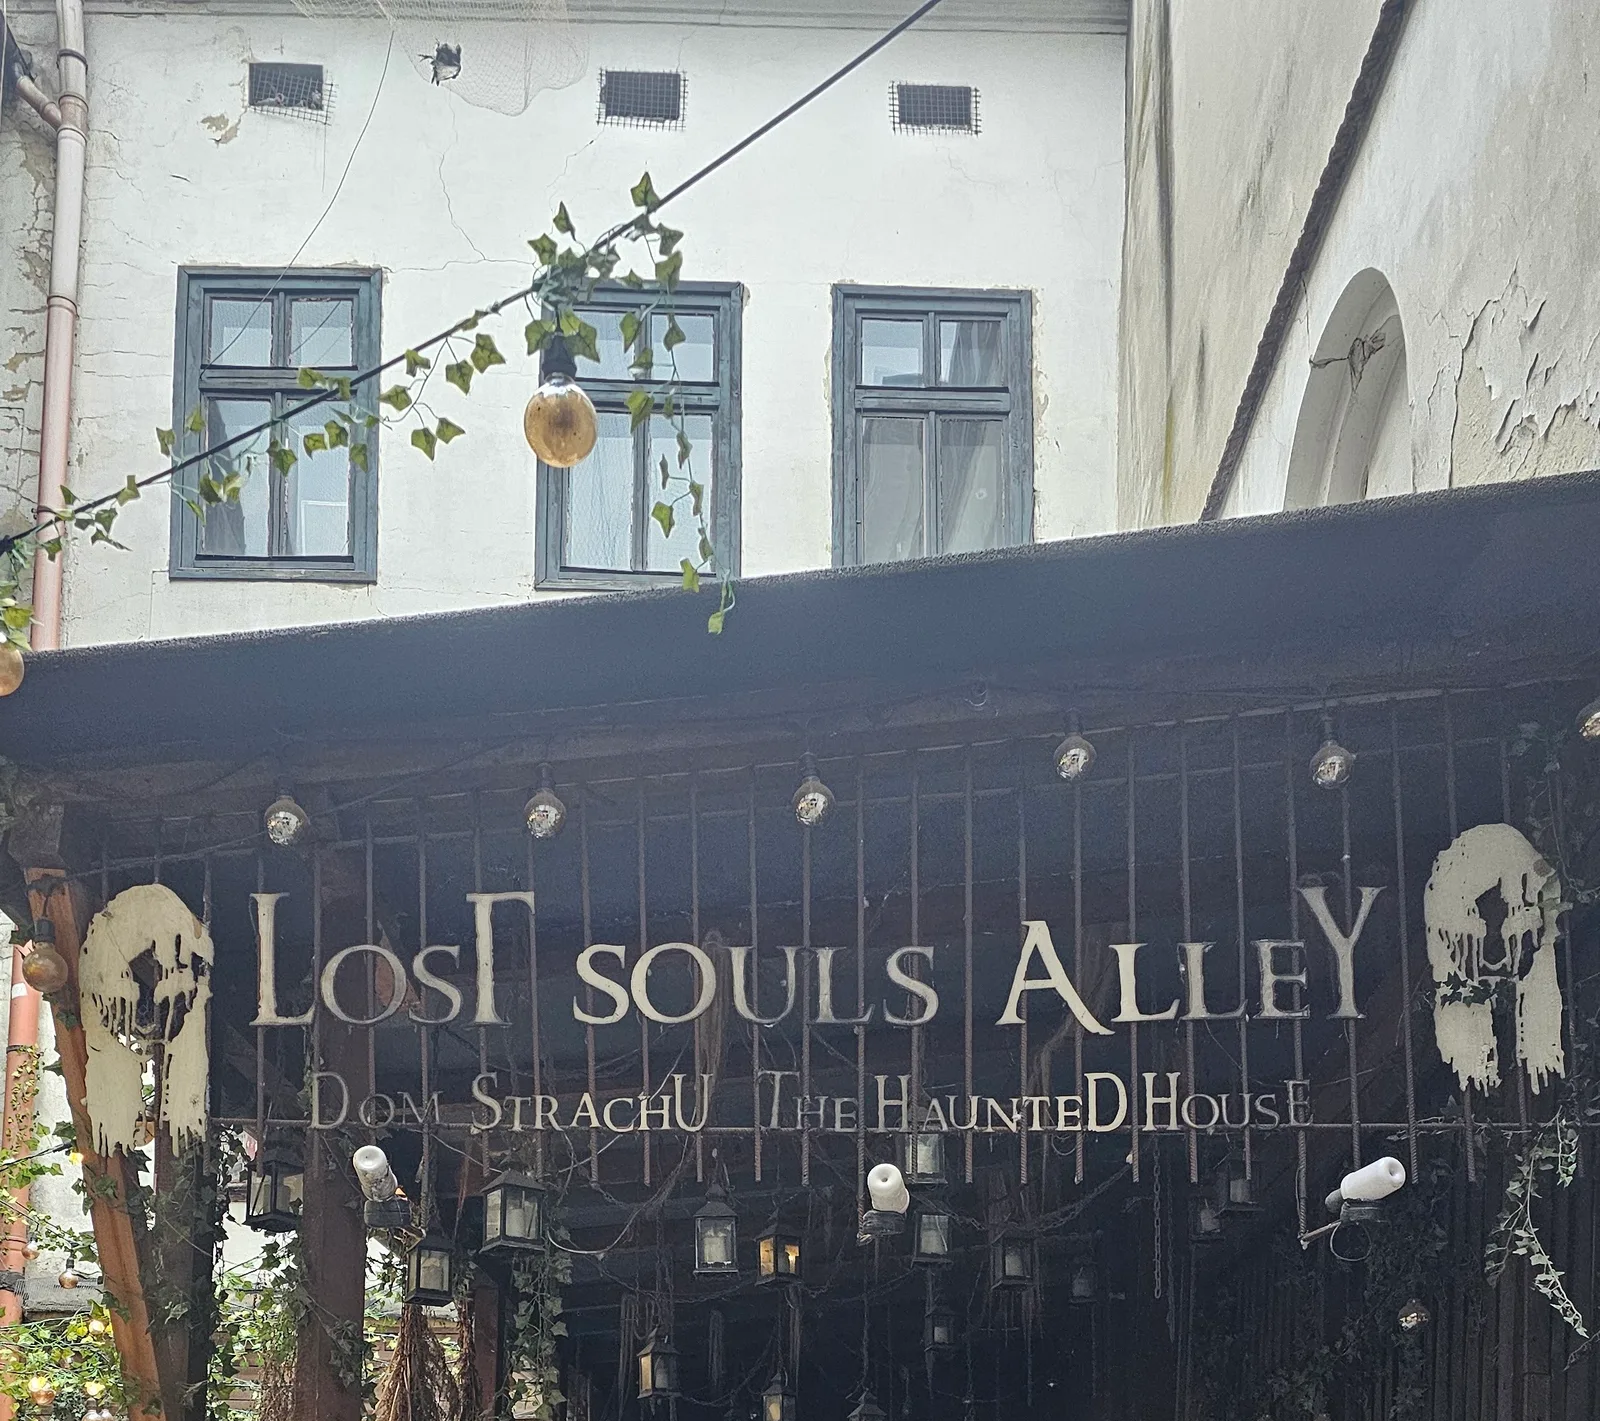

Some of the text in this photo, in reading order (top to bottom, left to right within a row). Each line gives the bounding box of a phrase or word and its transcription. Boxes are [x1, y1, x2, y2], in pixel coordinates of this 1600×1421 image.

[250, 886, 1387, 1036] LOST SOULS ALLEY
[308, 1070, 1316, 1133] DOM STRACHU THE HAUNTED HOUSE
